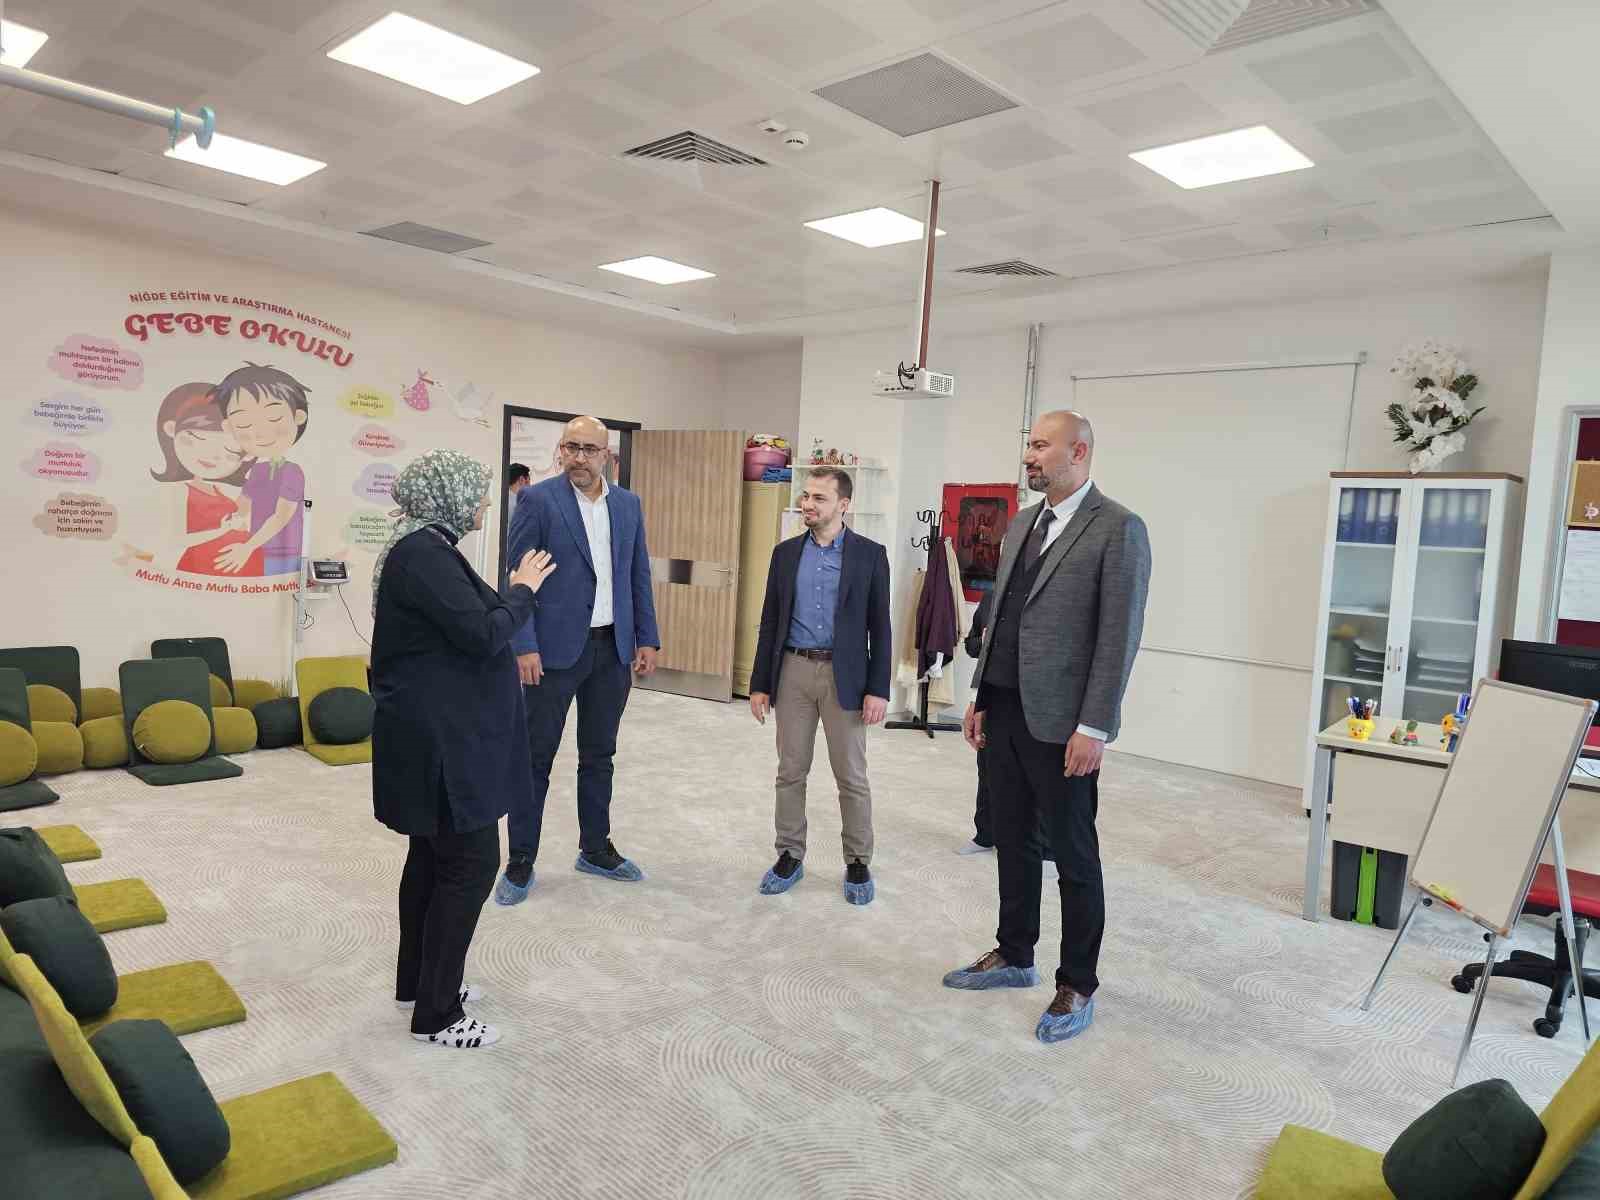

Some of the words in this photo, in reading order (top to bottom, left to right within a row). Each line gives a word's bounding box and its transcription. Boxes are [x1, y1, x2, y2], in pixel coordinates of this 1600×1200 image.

[125, 312, 232, 341] GEBE
[239, 319, 354, 367] OKULU
[170, 289, 211, 302] EĞİTİM
[213, 293, 229, 304] VE
[232, 296, 294, 317] ARAŞTIRMA
[297, 312, 351, 340] HASTANESİ
[135, 568, 170, 586] Mutlu
[172, 577, 203, 592] Anne
[206, 582, 239, 594] Mutlu
[241, 583, 271, 595] Baba
